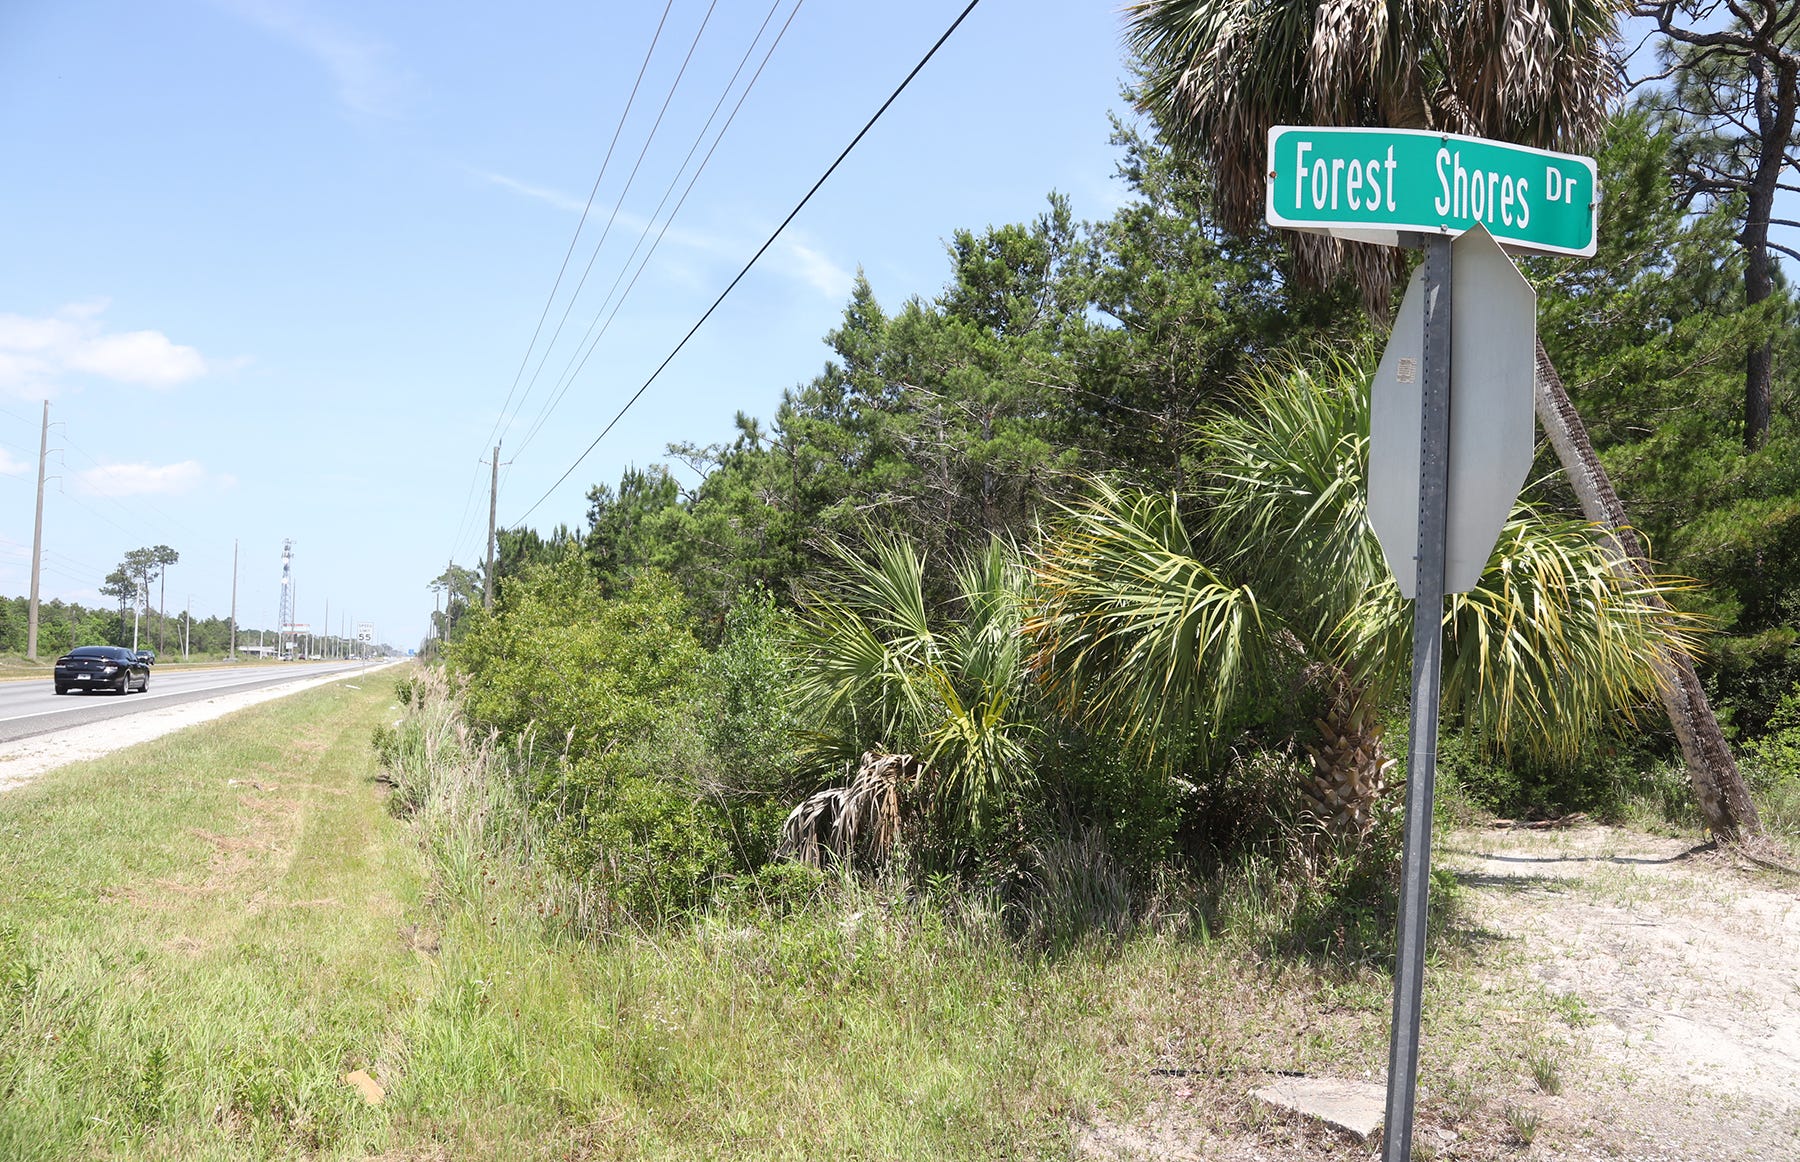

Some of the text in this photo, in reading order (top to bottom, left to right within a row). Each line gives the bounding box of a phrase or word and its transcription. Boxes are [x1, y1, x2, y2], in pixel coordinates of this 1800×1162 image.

[1295, 141, 1577, 229] Forest Shores Dr
[358, 633, 371, 641] 55
